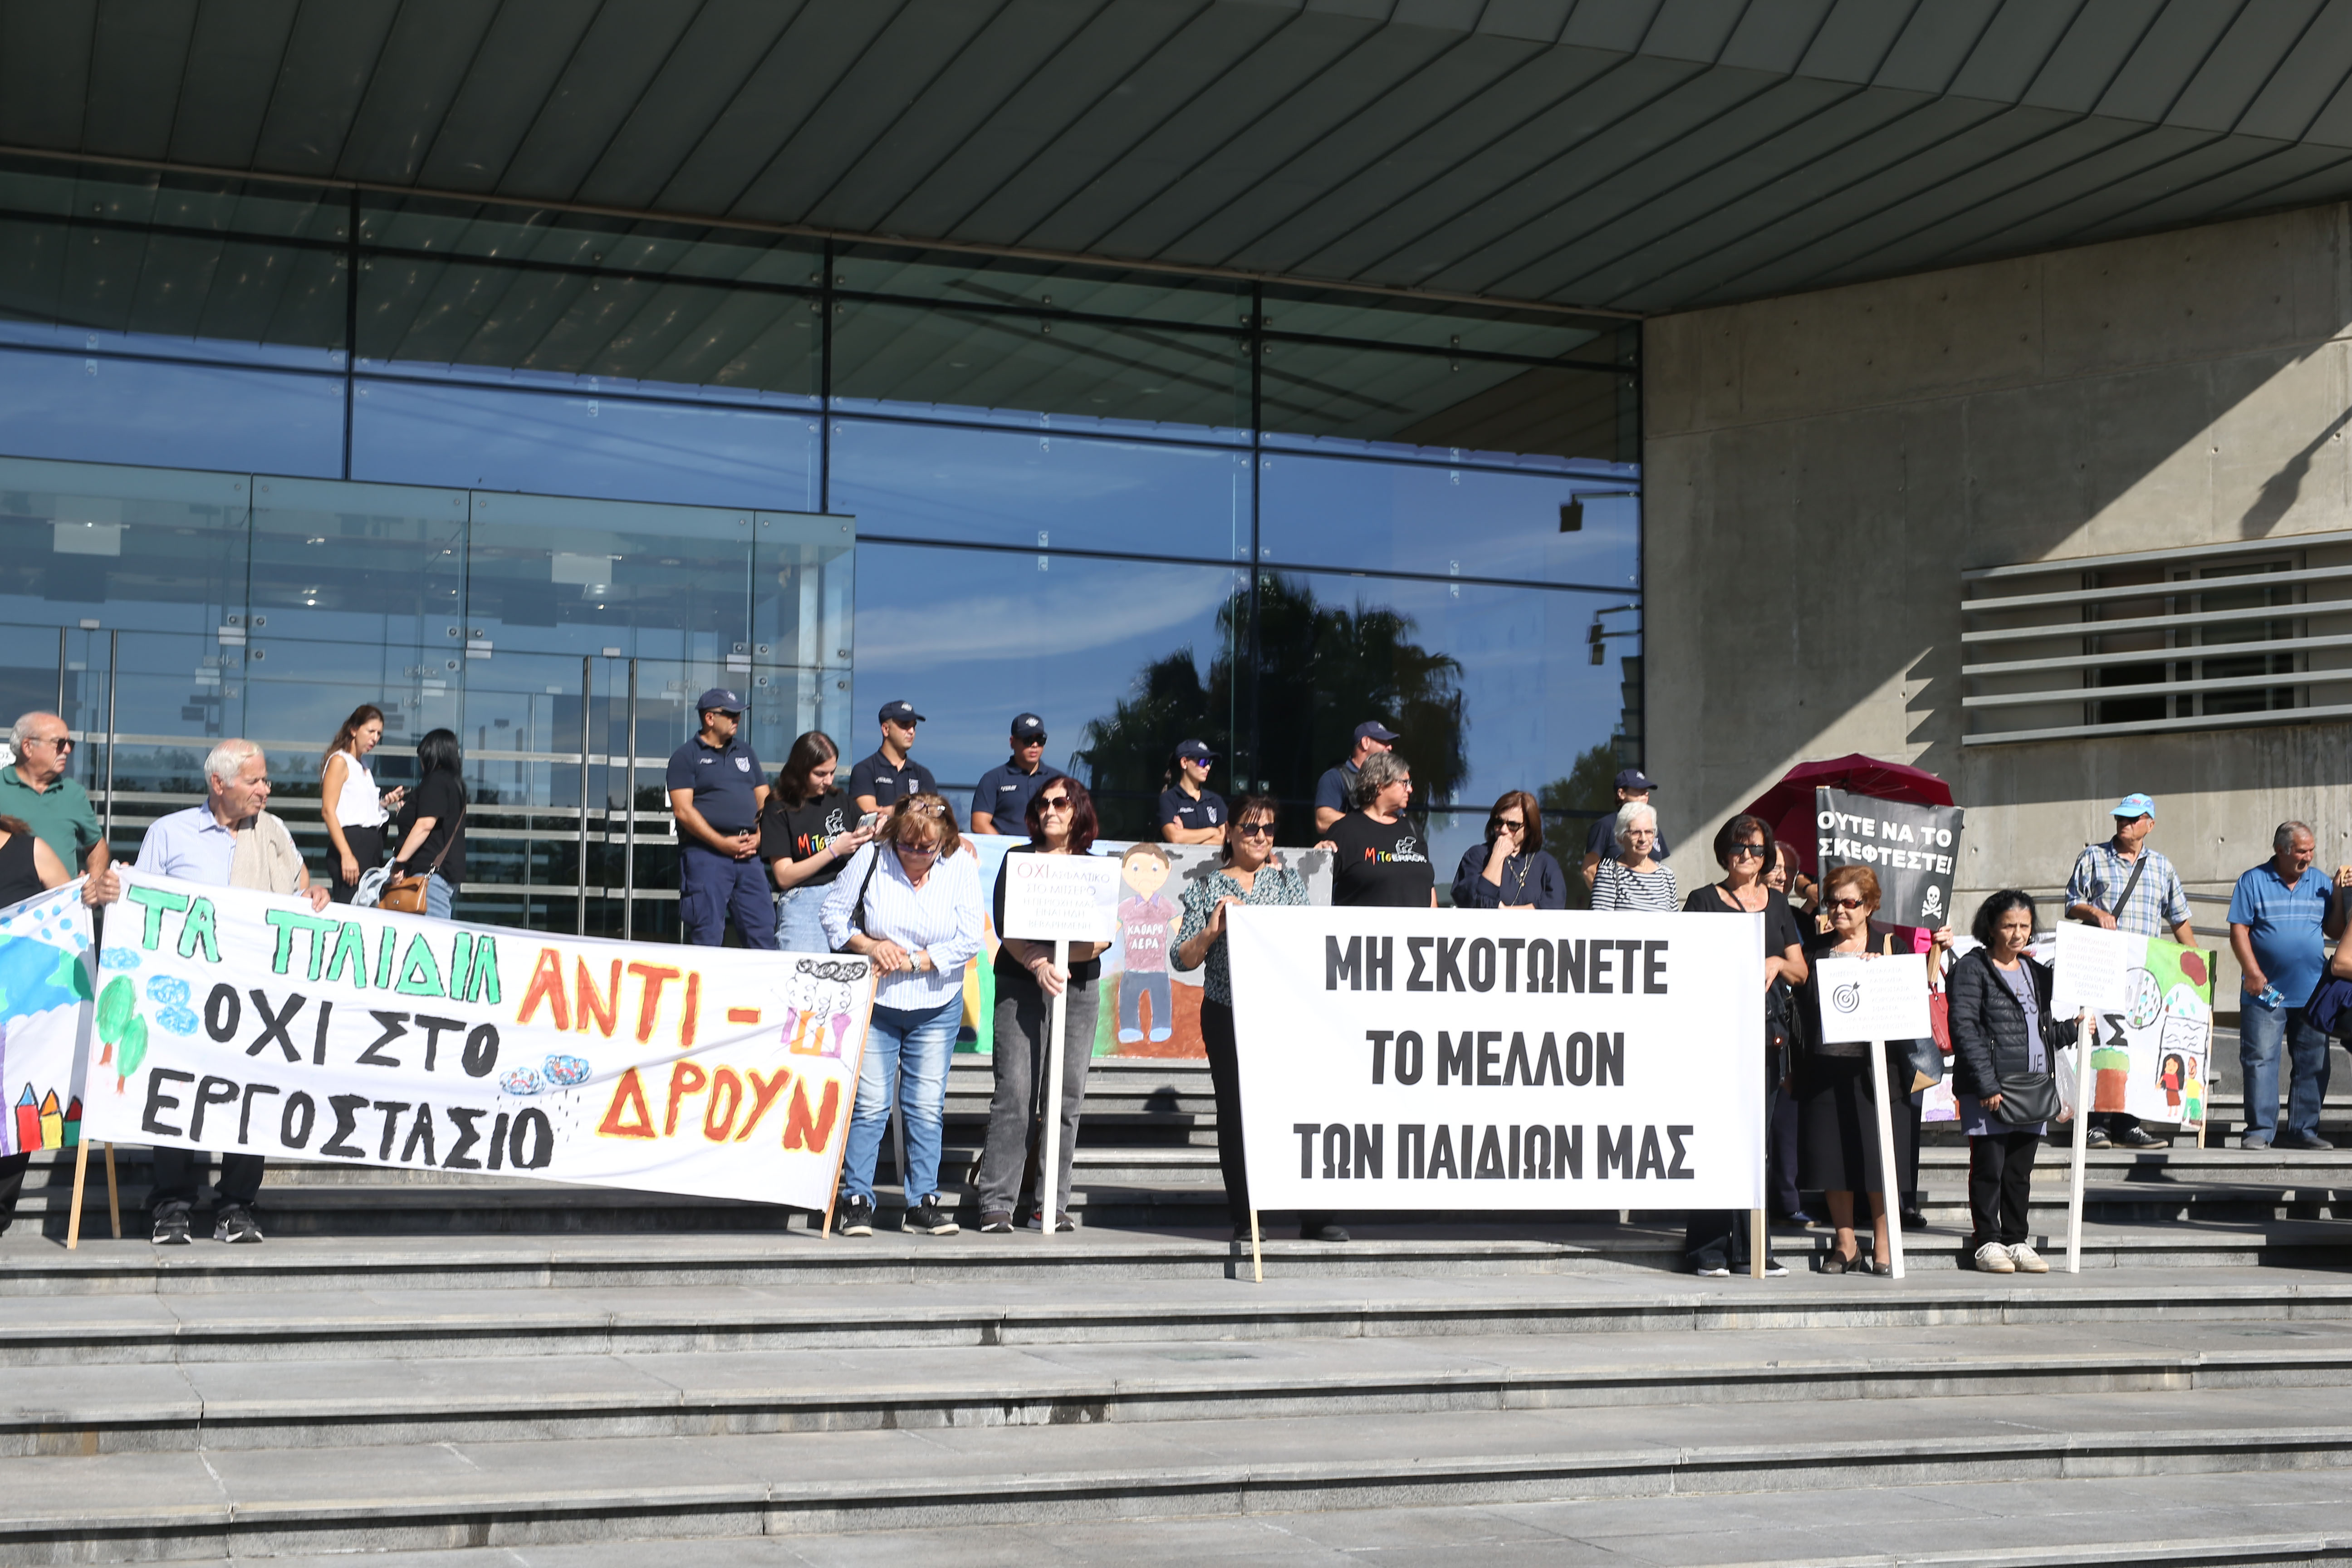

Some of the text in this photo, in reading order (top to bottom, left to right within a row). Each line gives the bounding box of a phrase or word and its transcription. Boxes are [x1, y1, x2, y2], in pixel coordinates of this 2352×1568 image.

[1817, 810, 1952, 848] ΟΥΤΕ ΝΑ ΤΟ
[1818, 838, 1953, 875] ΣΚΕΦΤΕΣΤΕ!
[1018, 862, 1110, 883] ΟΧΙ ΑΣΦΑΛΤΙΚΟ
[127, 884, 222, 963] ΤΑ
[266, 908, 501, 1004] ΠΑΙΔΙΑ
[1326, 935, 1669, 995] ΜΗ ΣΚΟΤΩΝΕΤΕ
[204, 983, 500, 1077] ΟΧΙ ΣΤΟ
[1366, 1030, 1624, 1086] ΤΟ ΜΕΛΛΟΝ
[142, 1068, 554, 1170] ΕΡΓΟΣΤΑΣΙΟ
[595, 1058, 843, 1154] ΔΡΟΥΝ
[1293, 1123, 1695, 1180] ΤΩΝ ΠΑΙΔΙΩΝ ΜΑΣ
